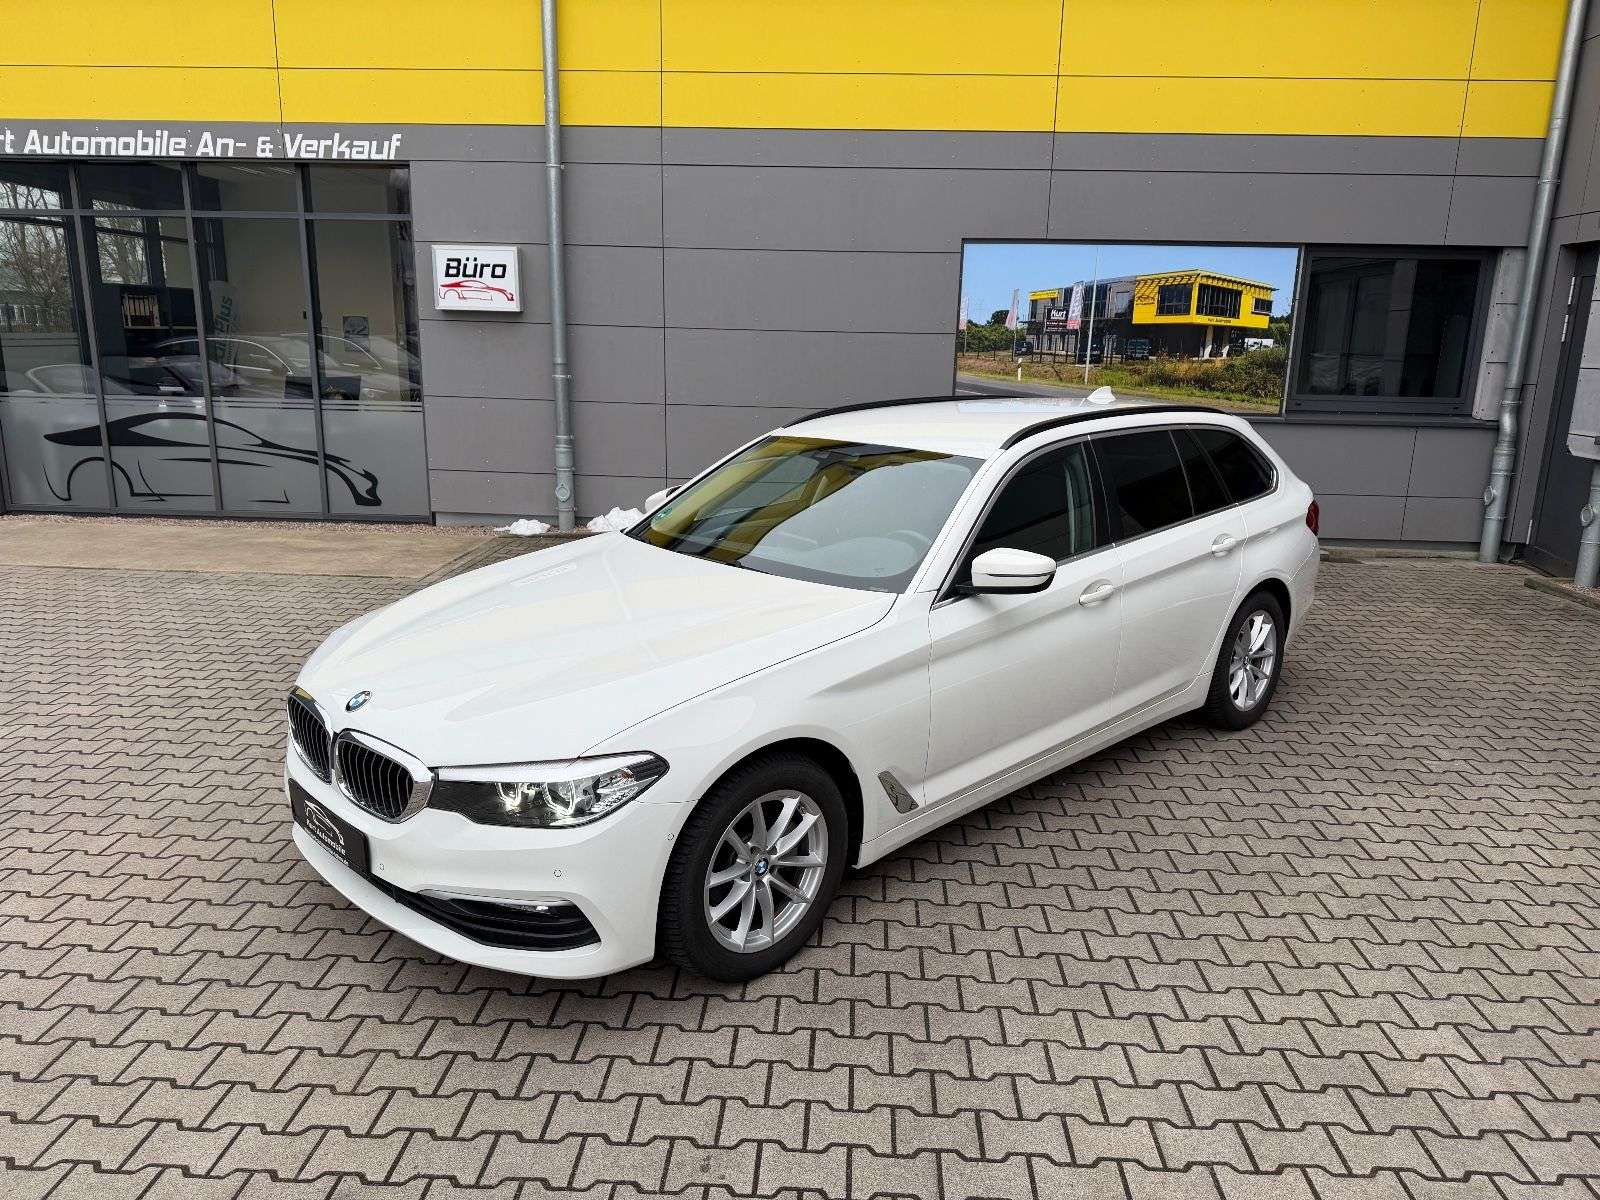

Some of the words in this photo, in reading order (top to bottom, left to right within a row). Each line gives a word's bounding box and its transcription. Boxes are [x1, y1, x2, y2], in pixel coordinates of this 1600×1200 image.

[23, 129, 187, 156] Automobile
[196, 131, 247, 157] An-
[256, 136, 274, 158] &
[283, 132, 402, 160] Verkauf
[444, 257, 507, 278] Büro
